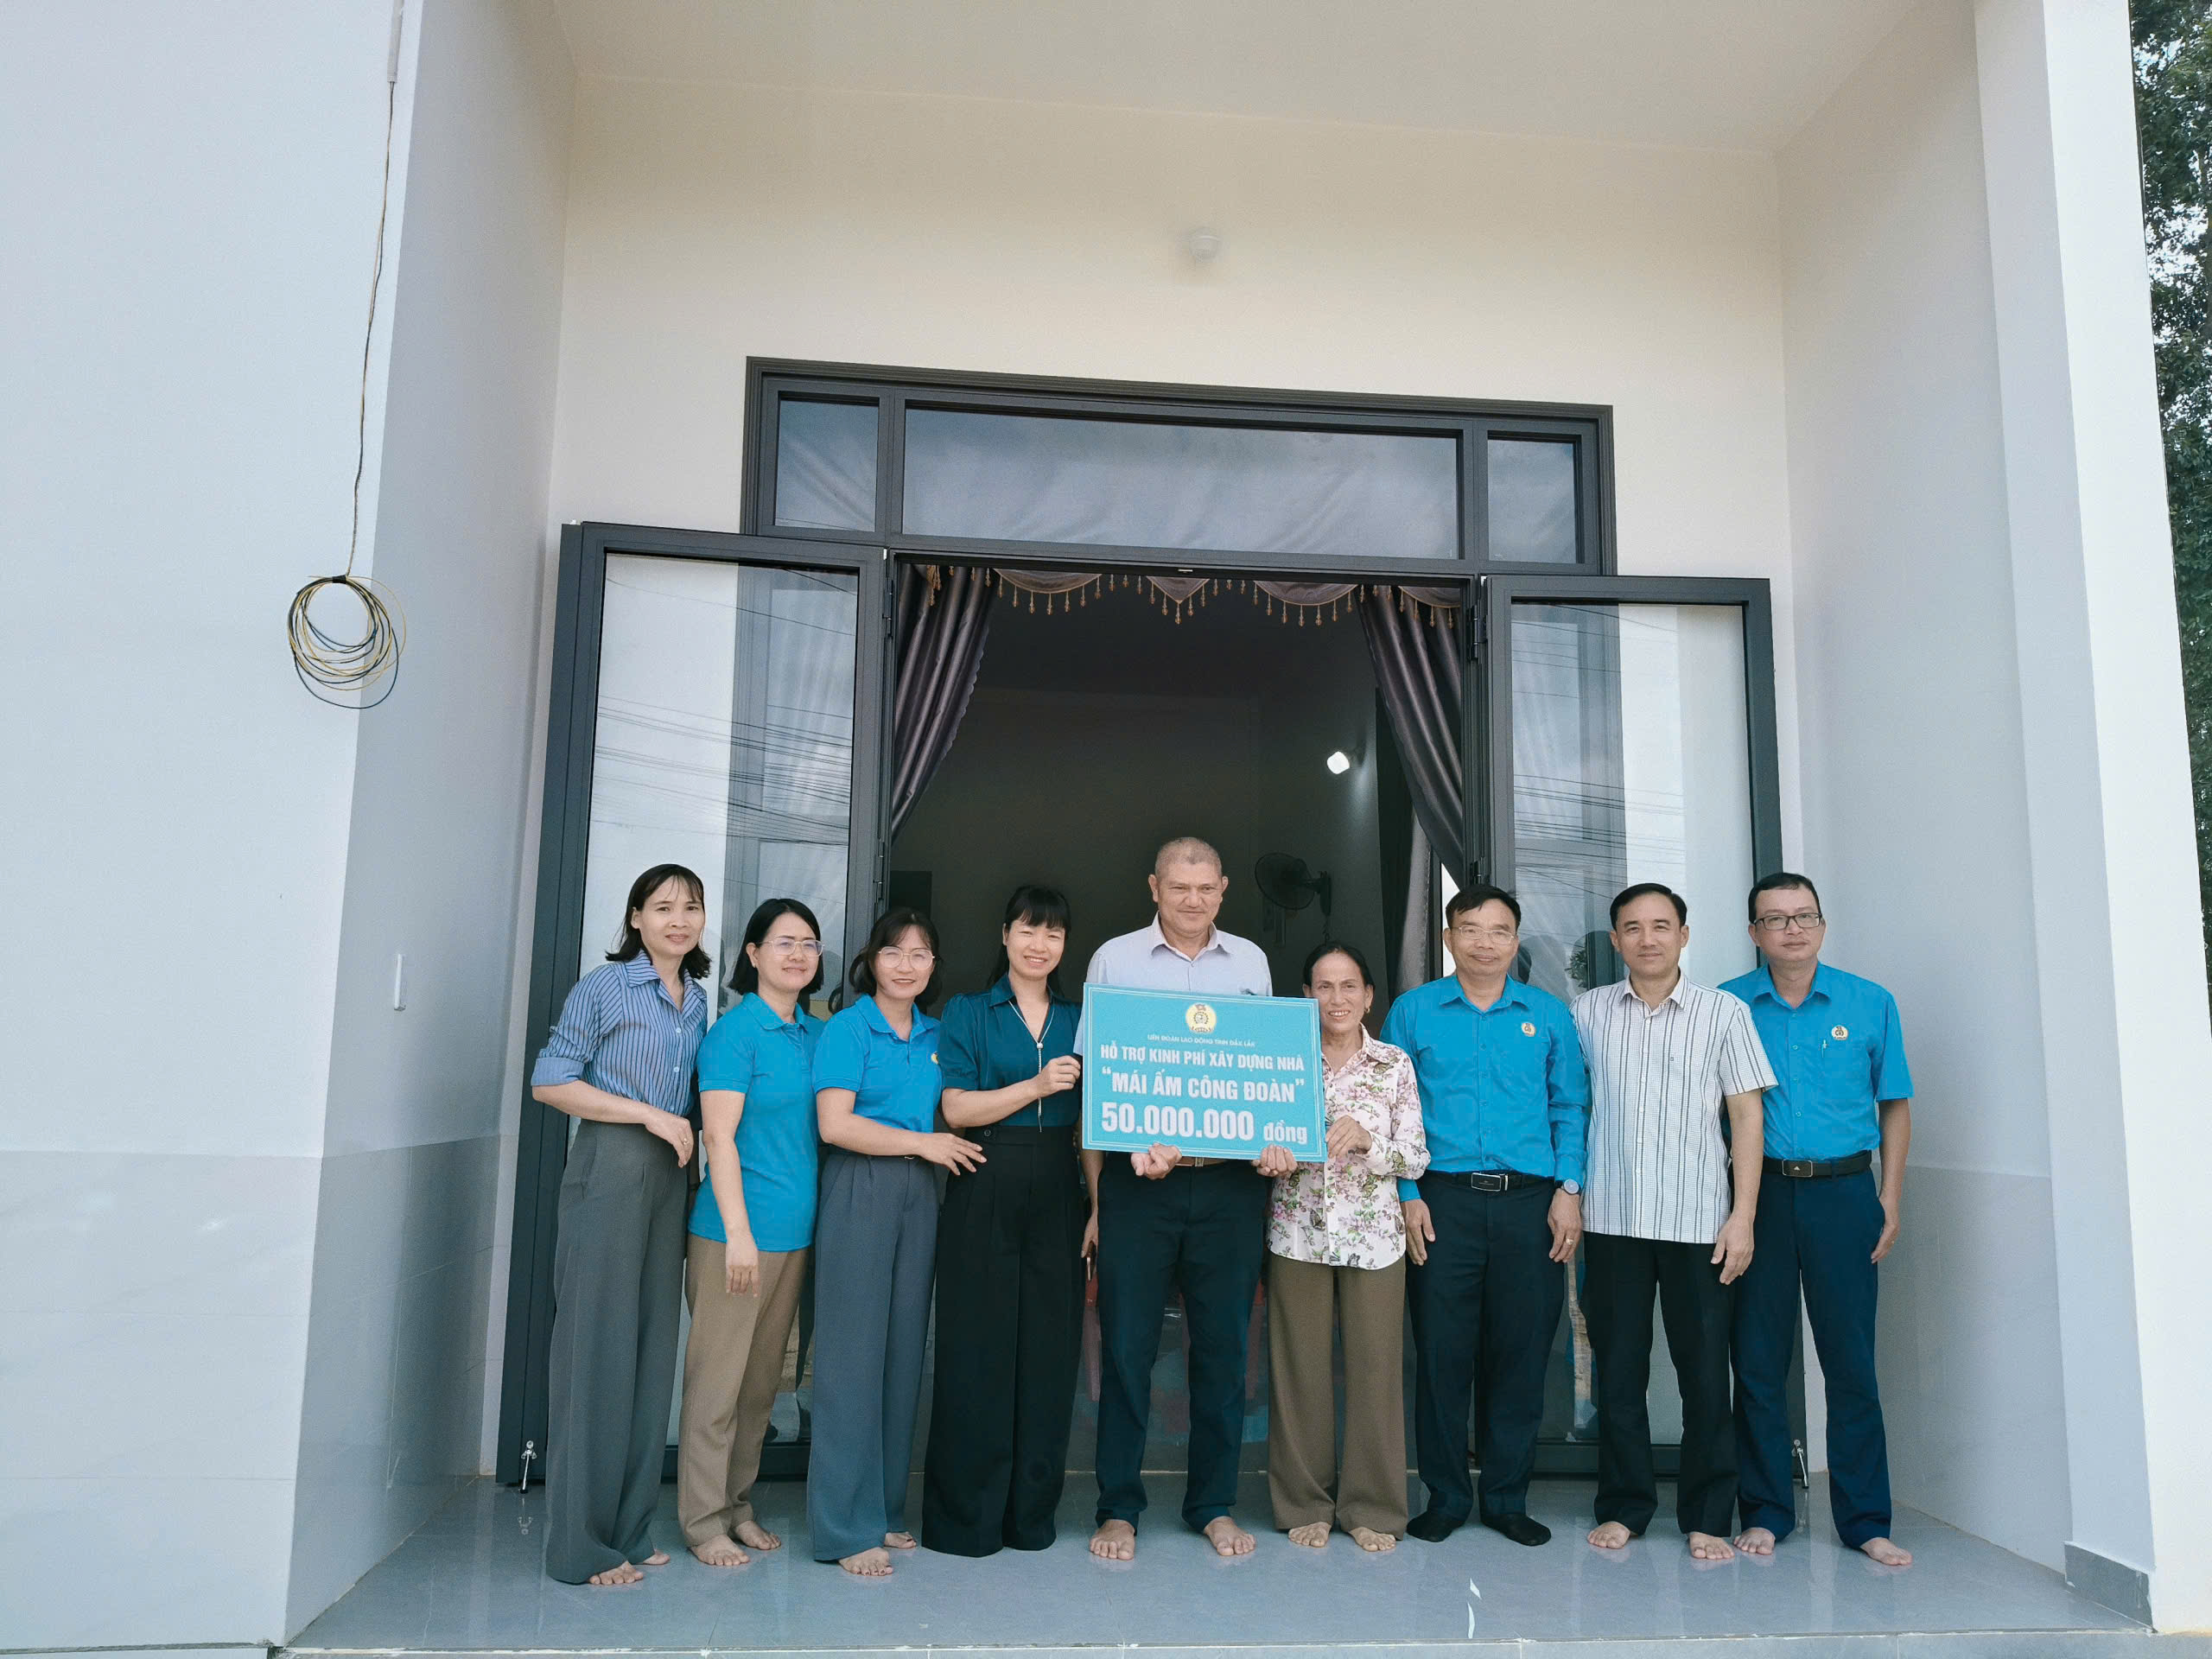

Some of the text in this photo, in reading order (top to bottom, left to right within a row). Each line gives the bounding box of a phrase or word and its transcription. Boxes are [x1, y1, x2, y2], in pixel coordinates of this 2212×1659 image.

[1122, 1046, 1146, 1065] TRỢ
[1149, 1048, 1180, 1065] KINH
[1184, 1049, 1205, 1065] PHÍ
[1209, 1052, 1233, 1068] XÂY
[1237, 1054, 1274, 1072] DỰNG
[1277, 1054, 1305, 1071] NHÀ
[1153, 1069, 1181, 1096] ẤM
[1187, 1074, 1238, 1100] CÔNG
[1102, 1102, 1307, 1145] 50.000.000 đồng
